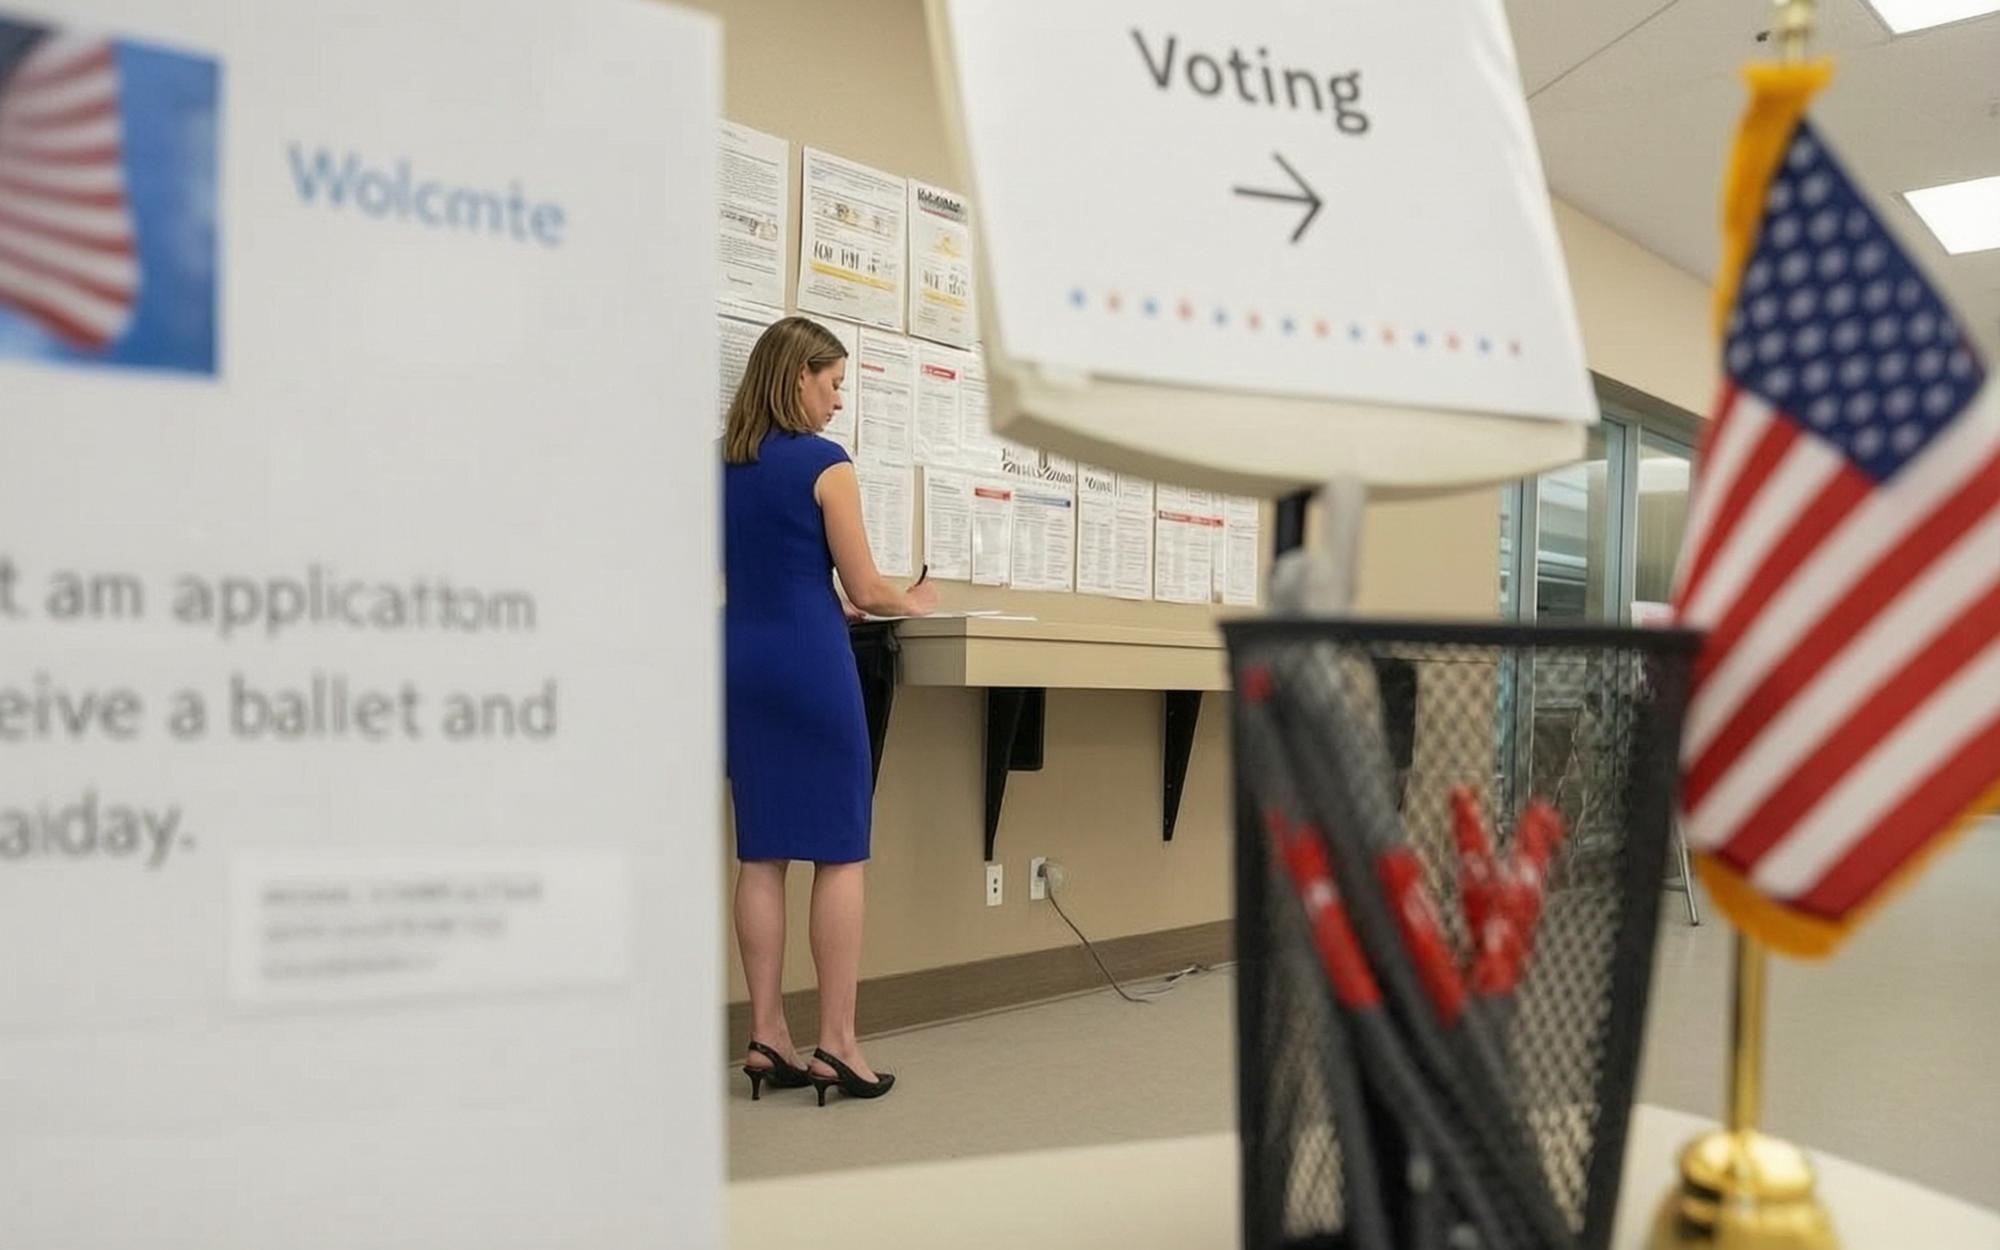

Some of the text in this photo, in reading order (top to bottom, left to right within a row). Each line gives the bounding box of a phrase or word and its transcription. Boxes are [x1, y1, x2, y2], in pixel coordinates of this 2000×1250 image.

[1132, 28, 1370, 135] Voting
[46, 570, 144, 620] am
[0, 671, 140, 741] eive
[168, 688, 207, 741] a
[443, 678, 557, 739] and
